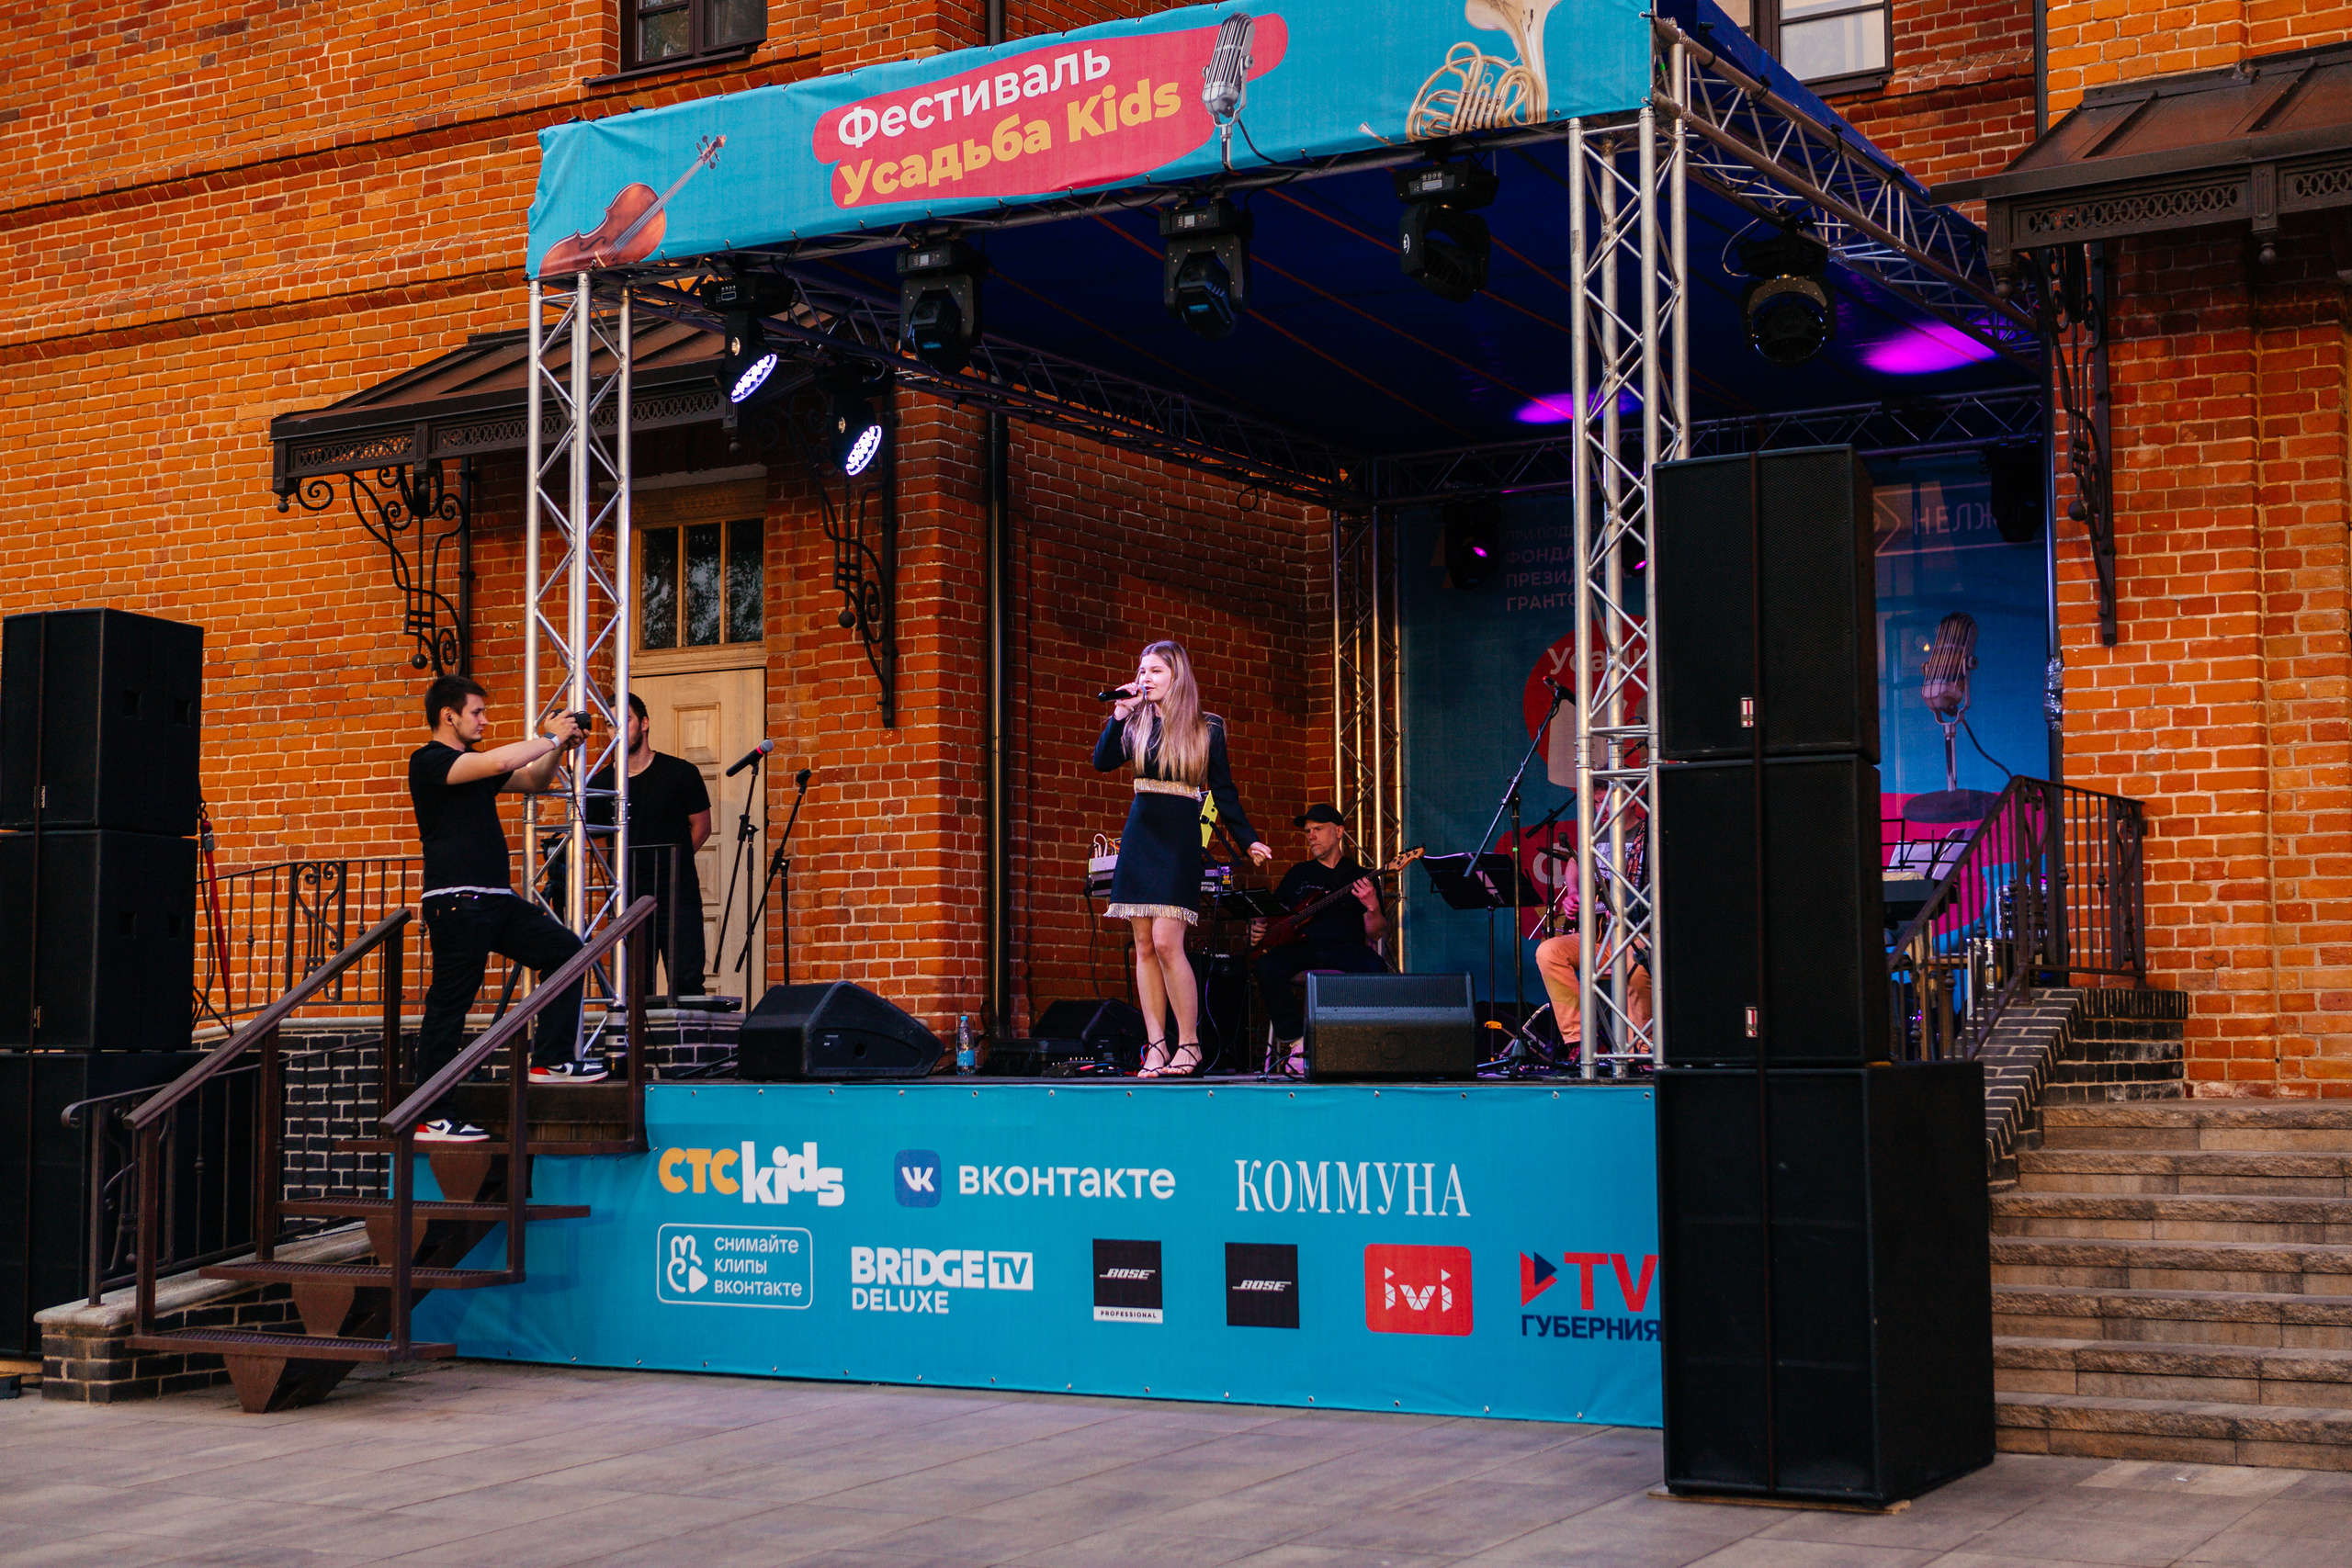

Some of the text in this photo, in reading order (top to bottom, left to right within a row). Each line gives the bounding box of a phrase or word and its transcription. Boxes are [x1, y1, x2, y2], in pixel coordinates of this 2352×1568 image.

[839, 48, 1111, 149] Фестиваль
[839, 77, 1182, 206] Усадьба Kids
[1914, 502, 1996, 535] НЕЛЖ
[1235, 1159, 1472, 1216] КОММУНА
[714, 1235, 799, 1255] снимайте
[714, 1258, 767, 1275] клипы
[992, 1256, 1029, 1284] TV
[1099, 1268, 1156, 1280] BOSE
[714, 1279, 803, 1298] вконтакте
[1232, 1280, 1293, 1292] BOSE
[1564, 1252, 1659, 1313] TV
[852, 1287, 950, 1314] DELUXE
[1100, 1309, 1158, 1320] PROFESSIONAL
[1521, 1314, 1661, 1342] ГУБЕРНИЯ
